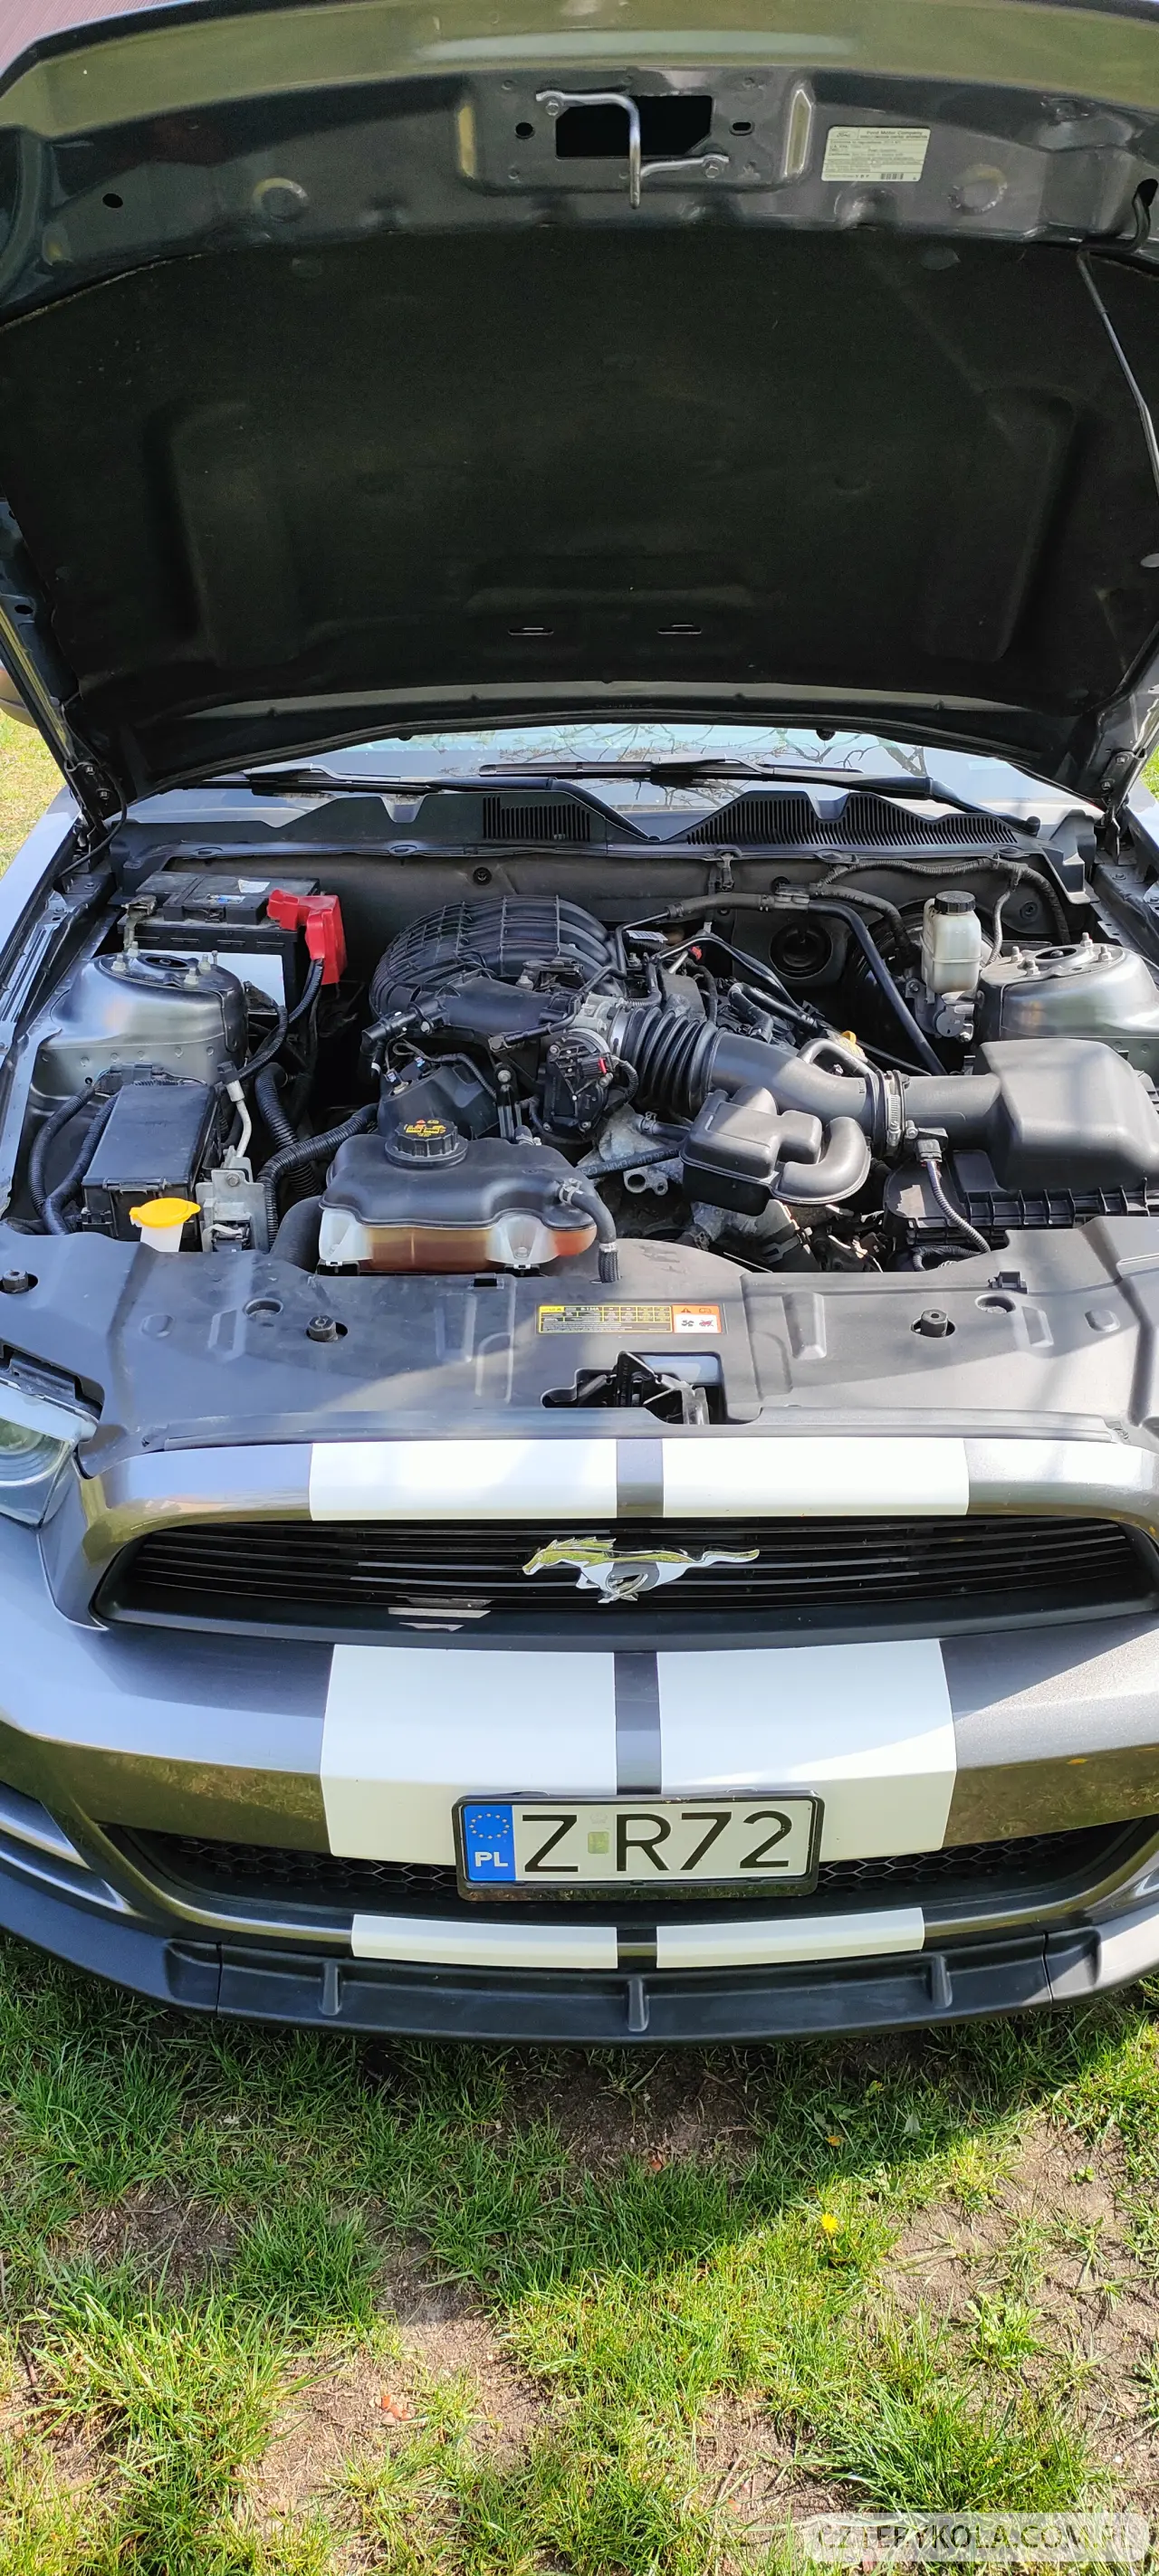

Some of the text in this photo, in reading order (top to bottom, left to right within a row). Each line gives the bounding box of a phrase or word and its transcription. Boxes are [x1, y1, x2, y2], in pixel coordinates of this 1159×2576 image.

[474, 1852, 508, 1868] PL
[522, 1810, 793, 1873] Z R72
